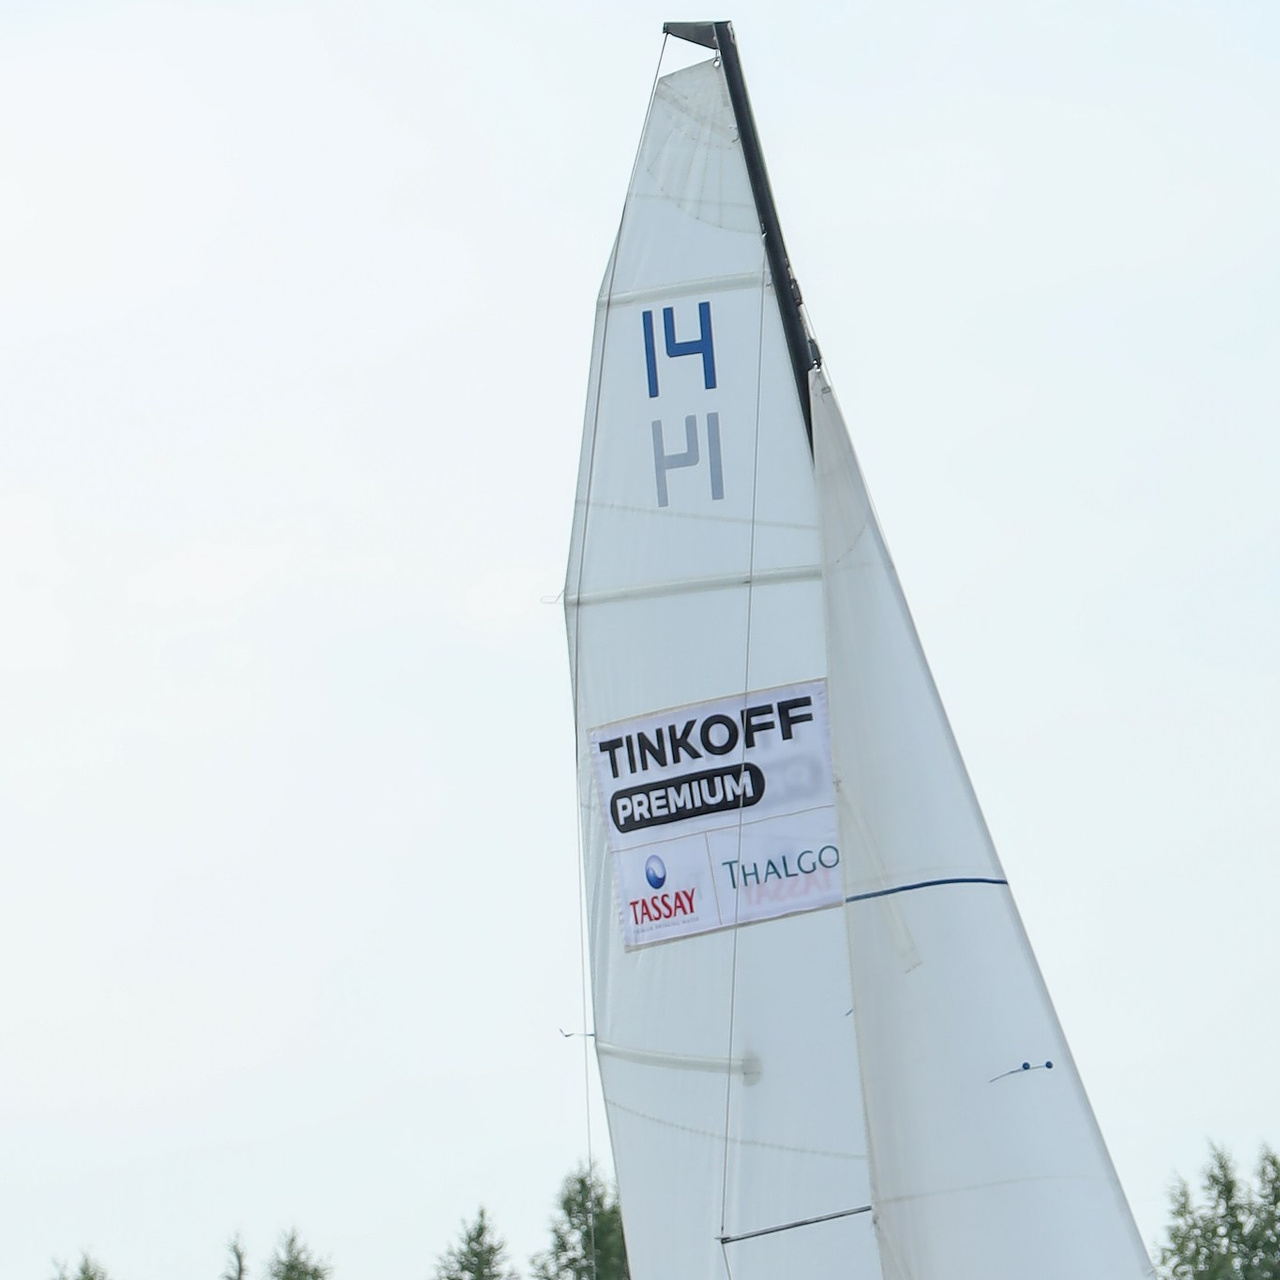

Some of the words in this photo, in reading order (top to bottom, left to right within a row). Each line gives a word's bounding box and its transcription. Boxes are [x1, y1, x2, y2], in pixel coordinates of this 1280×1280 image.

[642, 301, 717, 398] 14
[599, 696, 814, 778] TINKOFF
[615, 770, 754, 826] PREMIUM
[722, 845, 840, 889] THALGO
[630, 888, 695, 925] TASSAY
